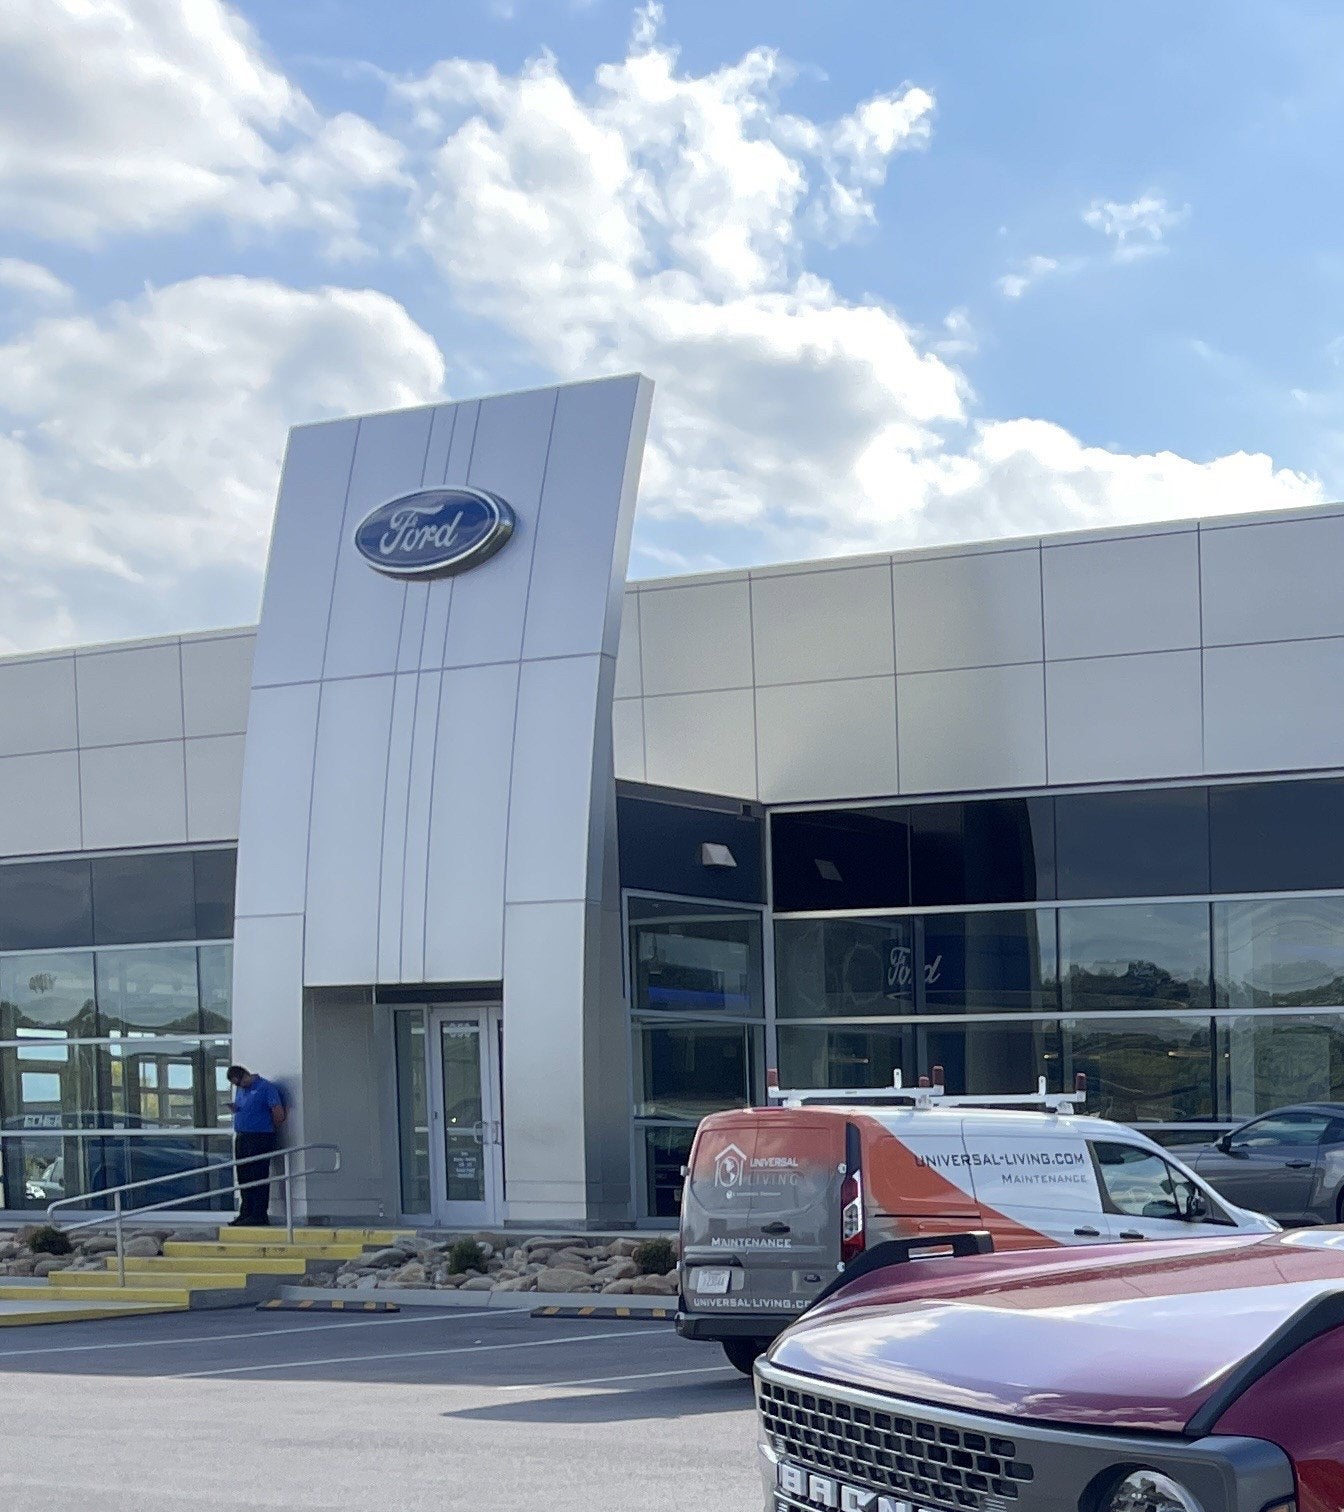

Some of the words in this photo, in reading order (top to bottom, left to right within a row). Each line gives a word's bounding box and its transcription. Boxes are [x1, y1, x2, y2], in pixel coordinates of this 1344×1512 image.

[380, 505, 463, 555] Ford
[750, 1157, 798, 1168] UNIVERSAL
[914, 1153, 1085, 1167] UNIVERSAL-LIVING.COM
